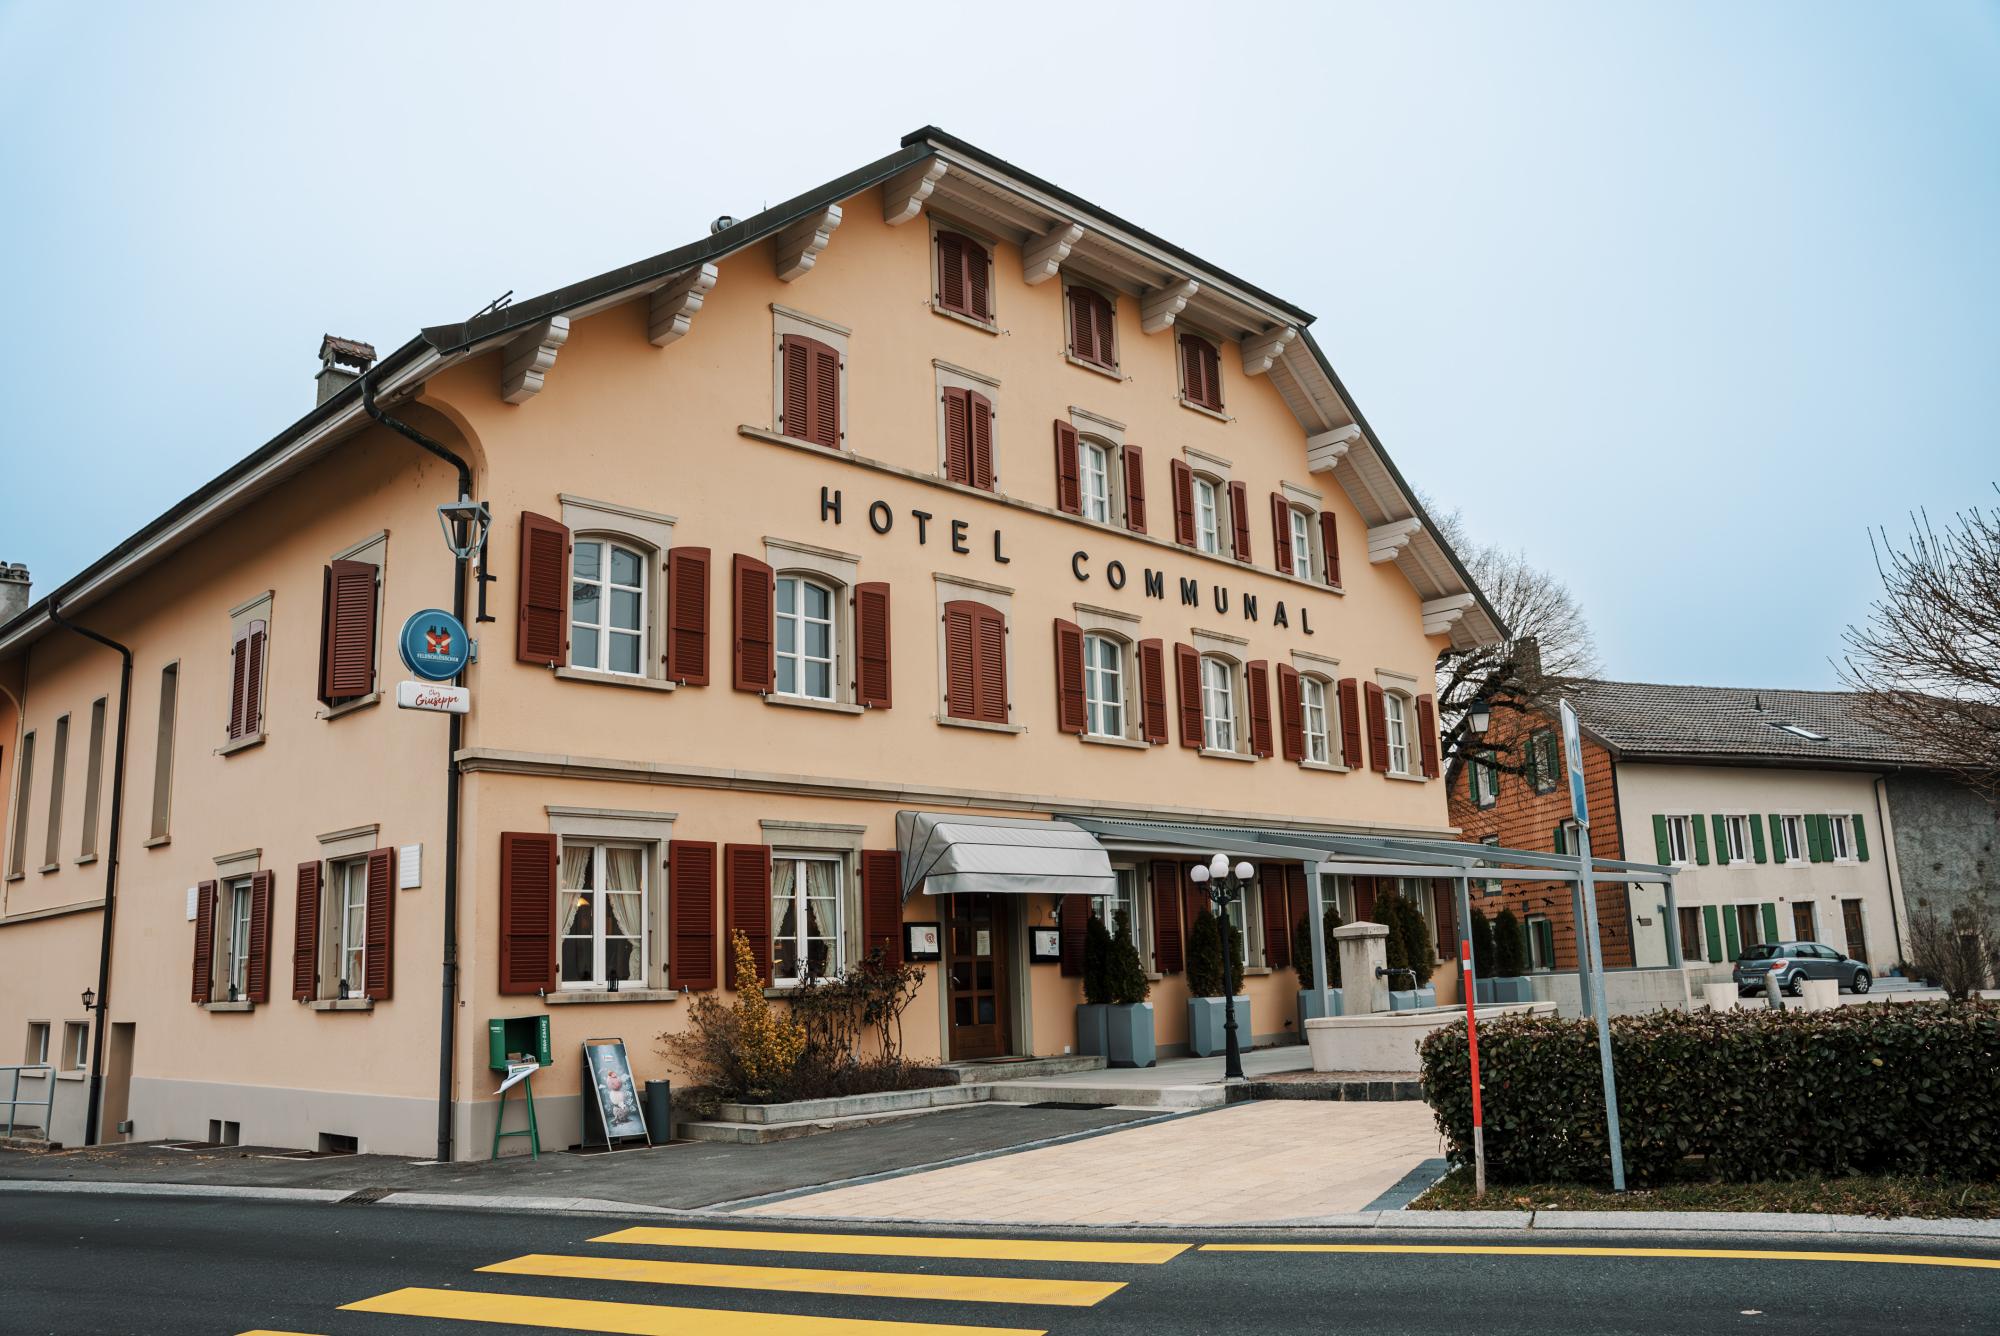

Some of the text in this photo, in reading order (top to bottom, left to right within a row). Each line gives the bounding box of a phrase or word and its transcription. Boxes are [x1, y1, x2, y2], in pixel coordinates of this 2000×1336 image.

[820, 485, 1315, 635] HOTEL COMMUNAL
[415, 694, 458, 708] Giuseppe
